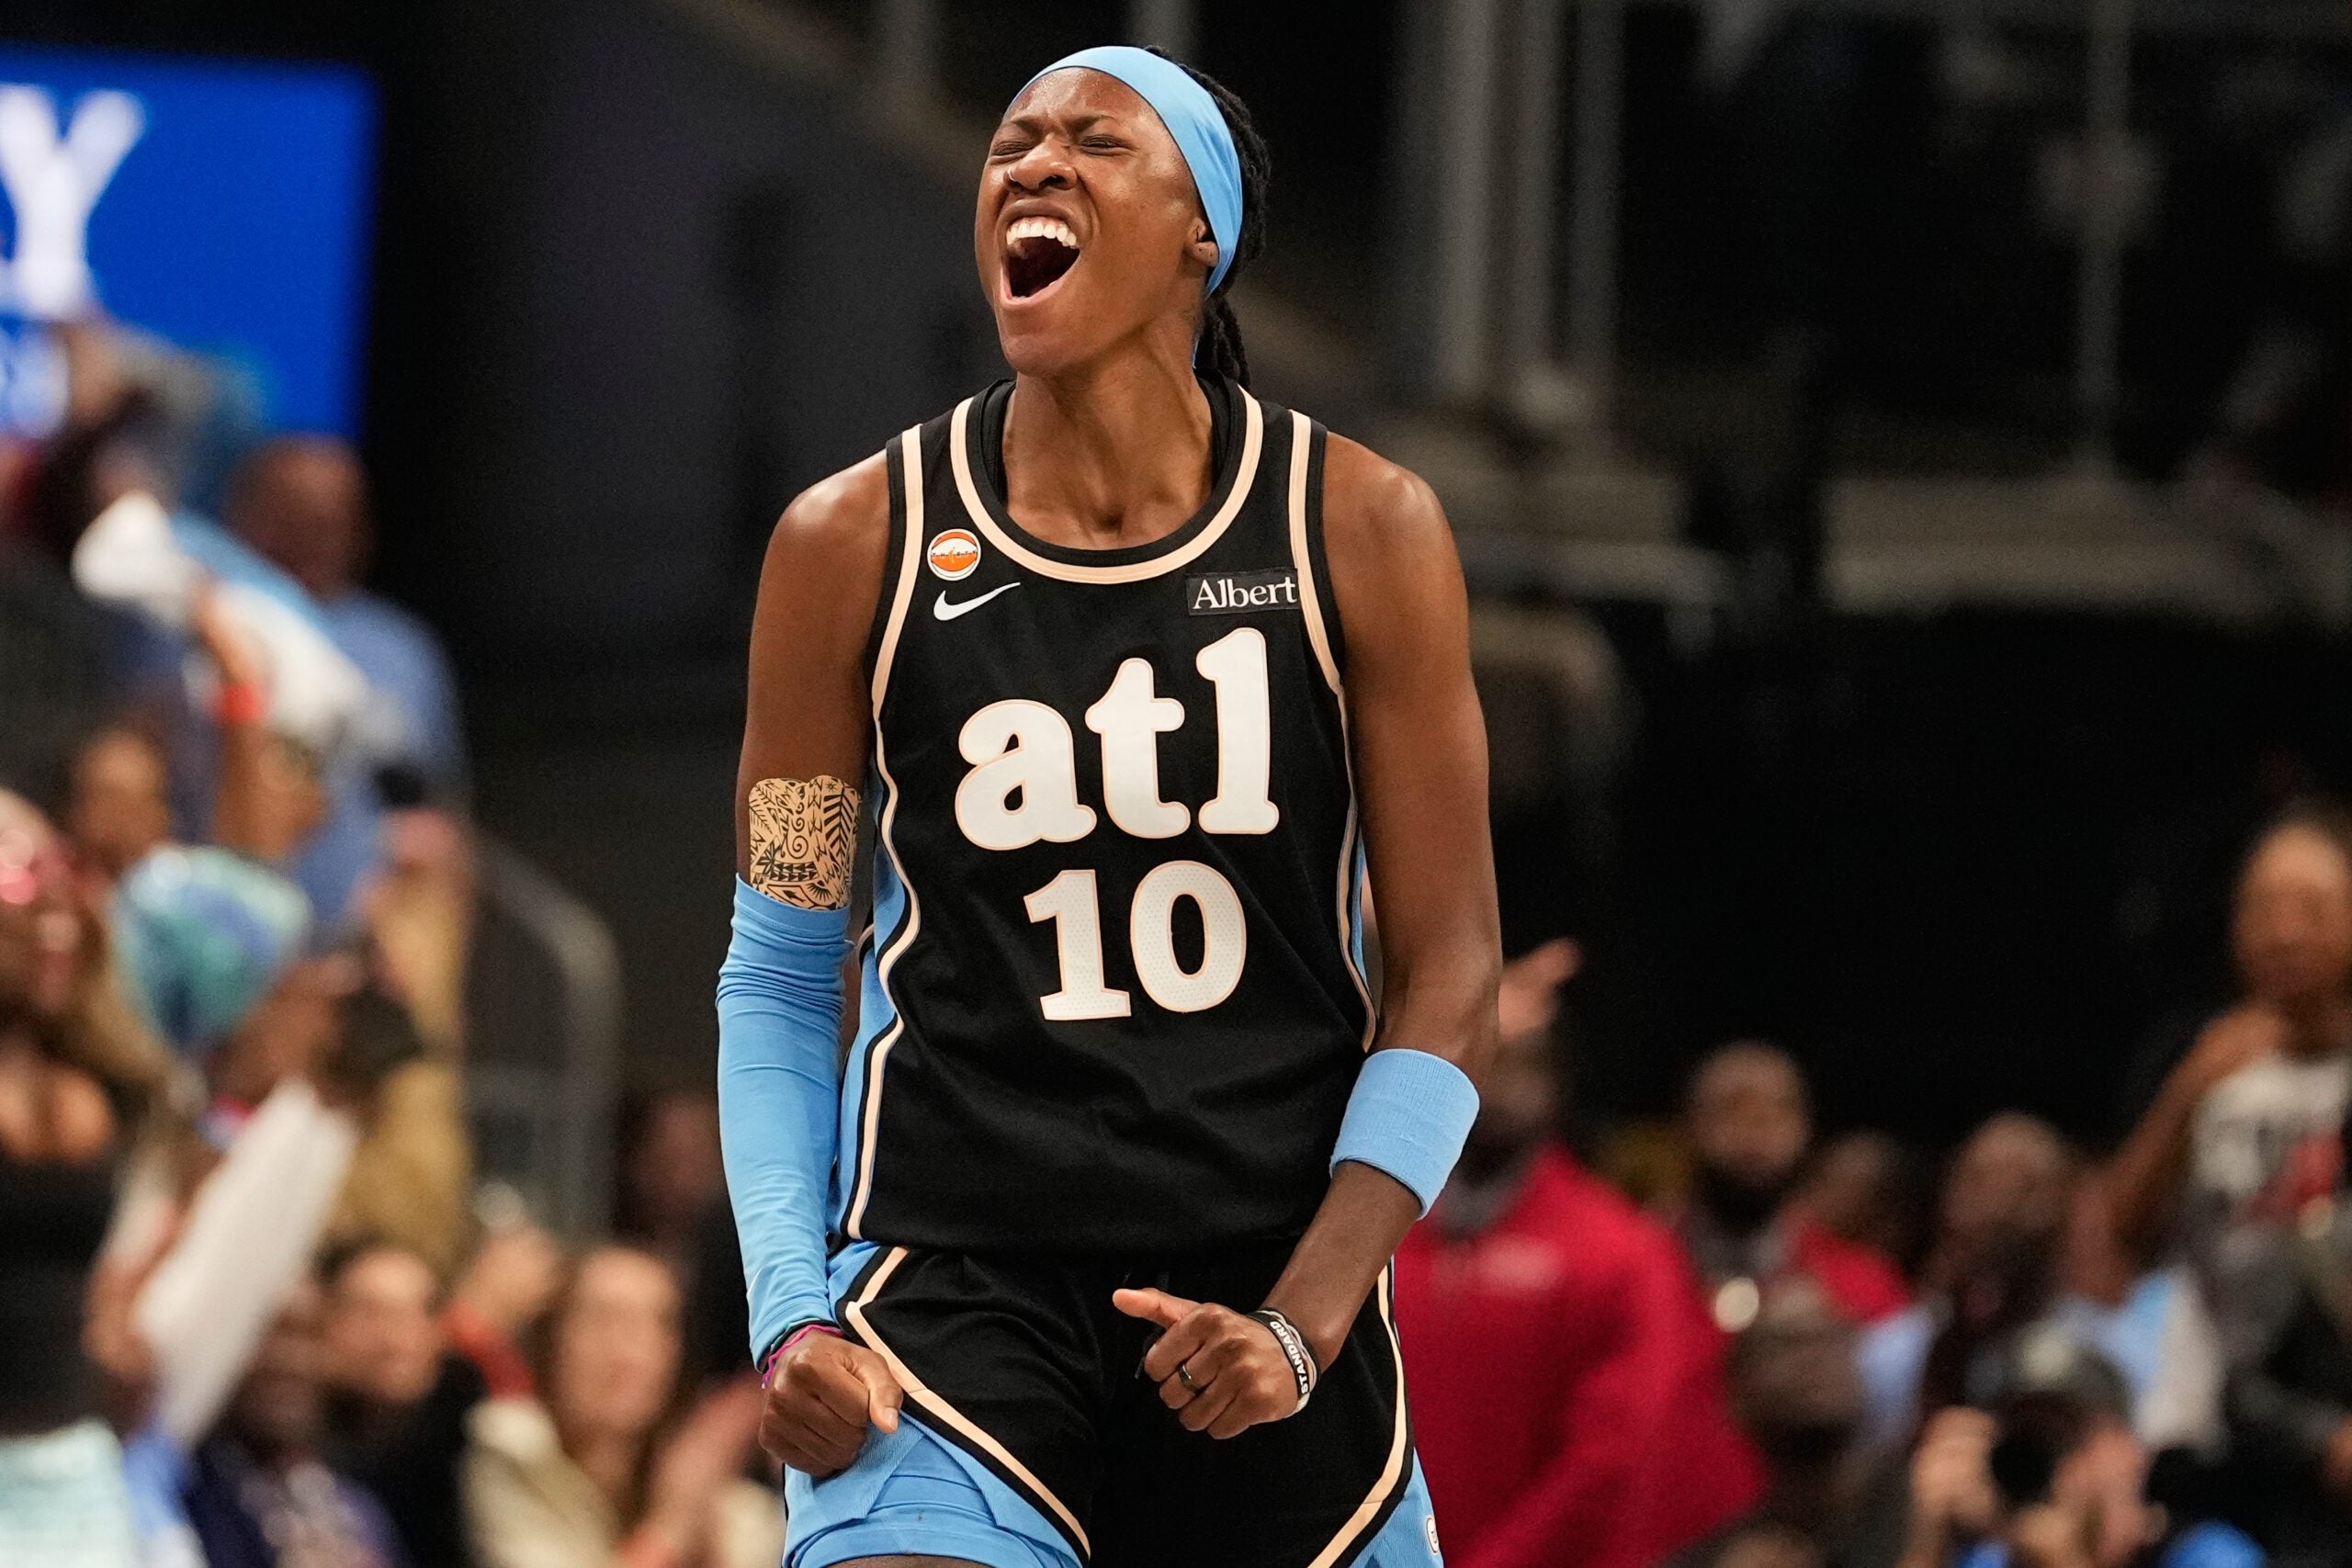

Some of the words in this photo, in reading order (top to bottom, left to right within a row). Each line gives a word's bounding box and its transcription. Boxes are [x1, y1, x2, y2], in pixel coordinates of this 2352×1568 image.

[1193, 576, 1297, 609] Albert
[955, 627, 1280, 851] atl
[1023, 861, 1247, 1021] 10
[1269, 1321, 1308, 1394] STANDARD
